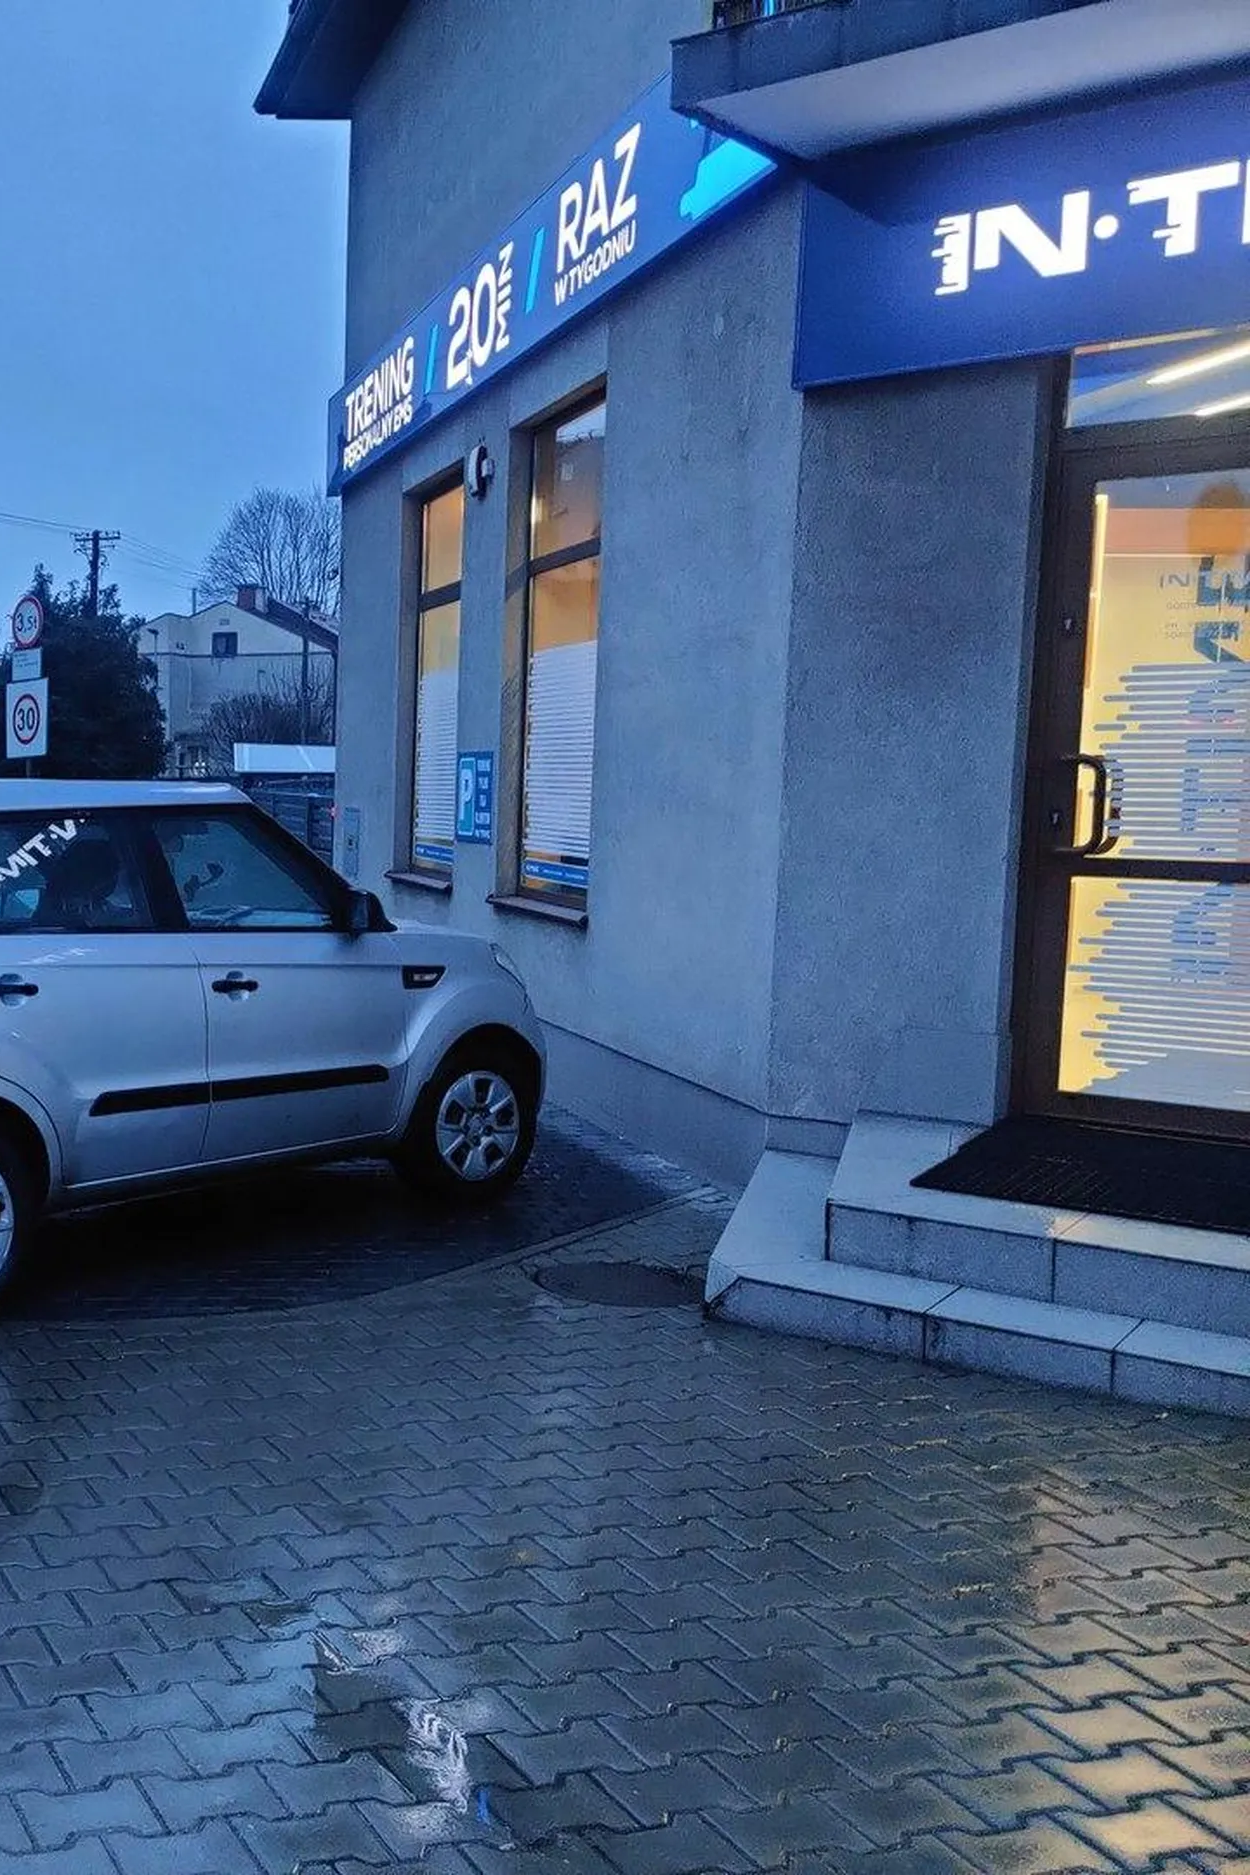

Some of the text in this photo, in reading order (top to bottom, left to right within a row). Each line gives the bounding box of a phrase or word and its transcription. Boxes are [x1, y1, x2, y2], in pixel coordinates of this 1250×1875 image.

[557, 122, 641, 274] RAZ
[931, 158, 1250, 296] IN·T
[496, 241, 514, 353] MIN
[554, 219, 637, 306] W TYGODNIU
[447, 263, 497, 390] 20
[345, 335, 414, 442] TRENING
[16, 707, 36, 732] 30
[458, 768, 473, 821] P
